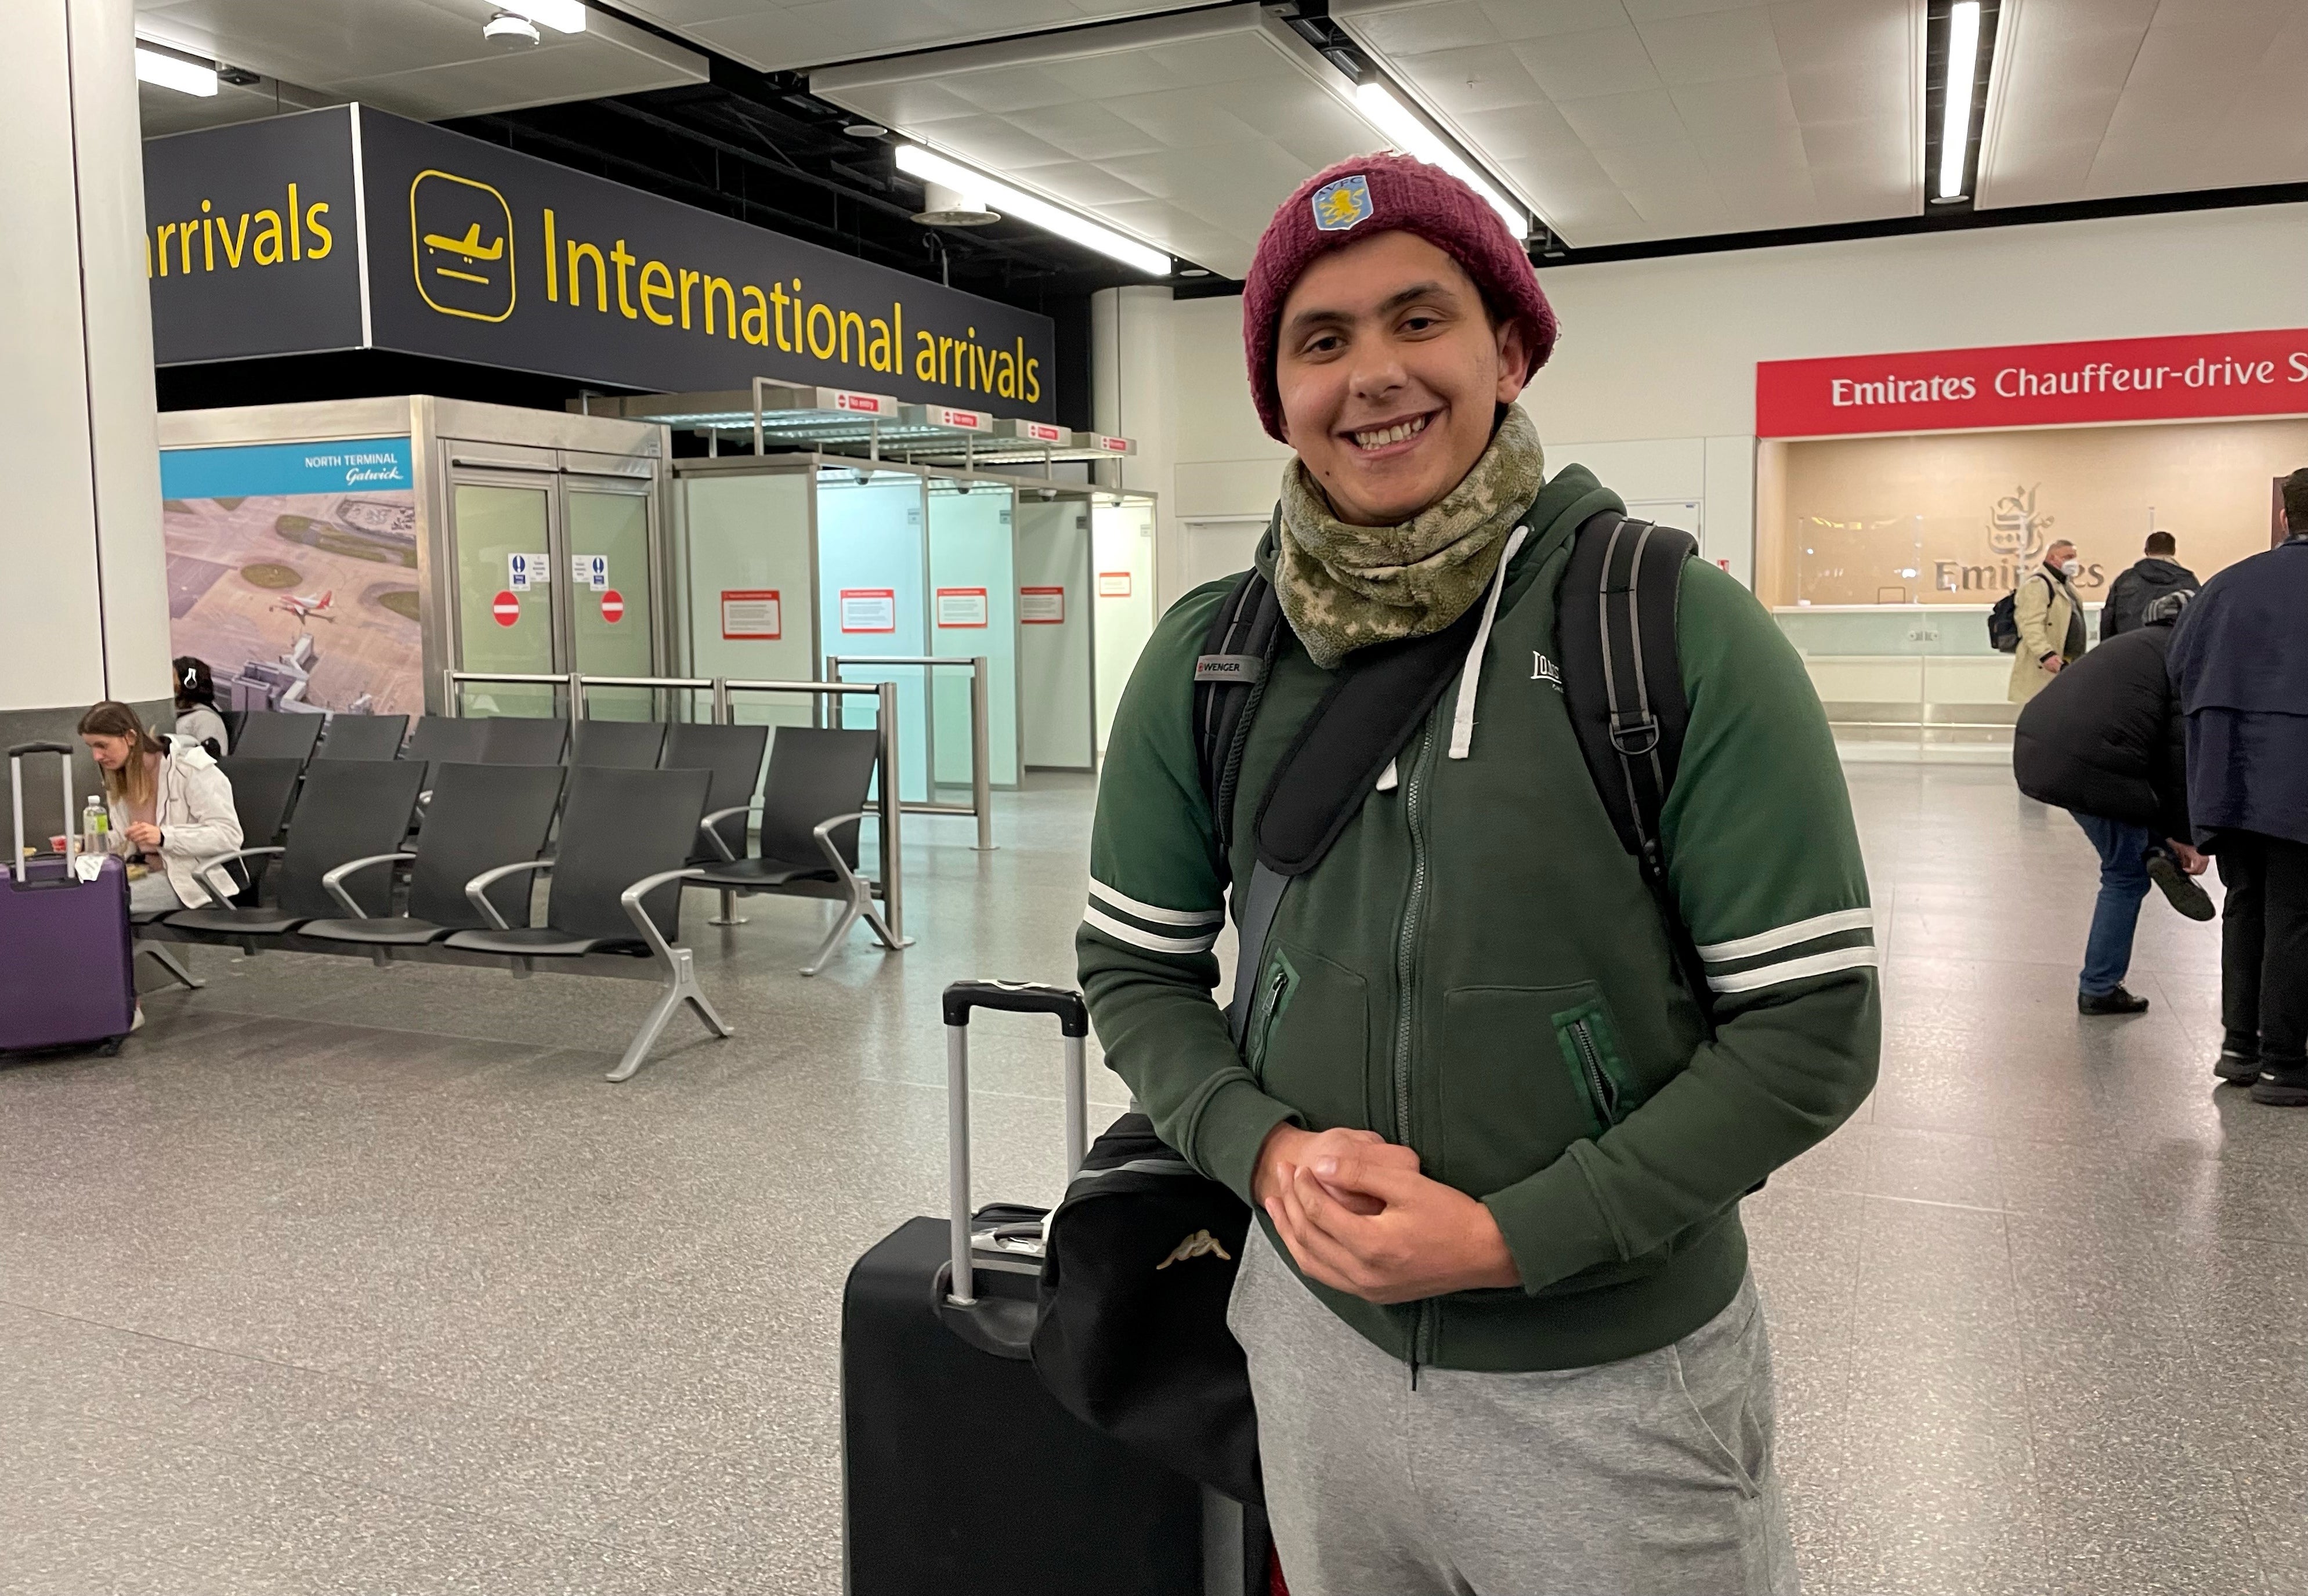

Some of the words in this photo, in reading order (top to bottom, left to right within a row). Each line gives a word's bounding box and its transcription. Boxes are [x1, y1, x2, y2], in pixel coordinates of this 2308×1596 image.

[1316, 176, 1363, 200] AVFC
[146, 183, 332, 278] rrivals
[544, 208, 903, 375] International
[916, 326, 1040, 403] arrivals
[1831, 375, 1976, 406] Emirates
[1995, 356, 2275, 397] Chauffeur-drive
[305, 455, 341, 468] NORTH
[344, 453, 397, 466] TERMINAL
[346, 466, 404, 486] Gatwick
[1933, 558, 2105, 591] Emires
[1204, 663, 1240, 671] WENGER
